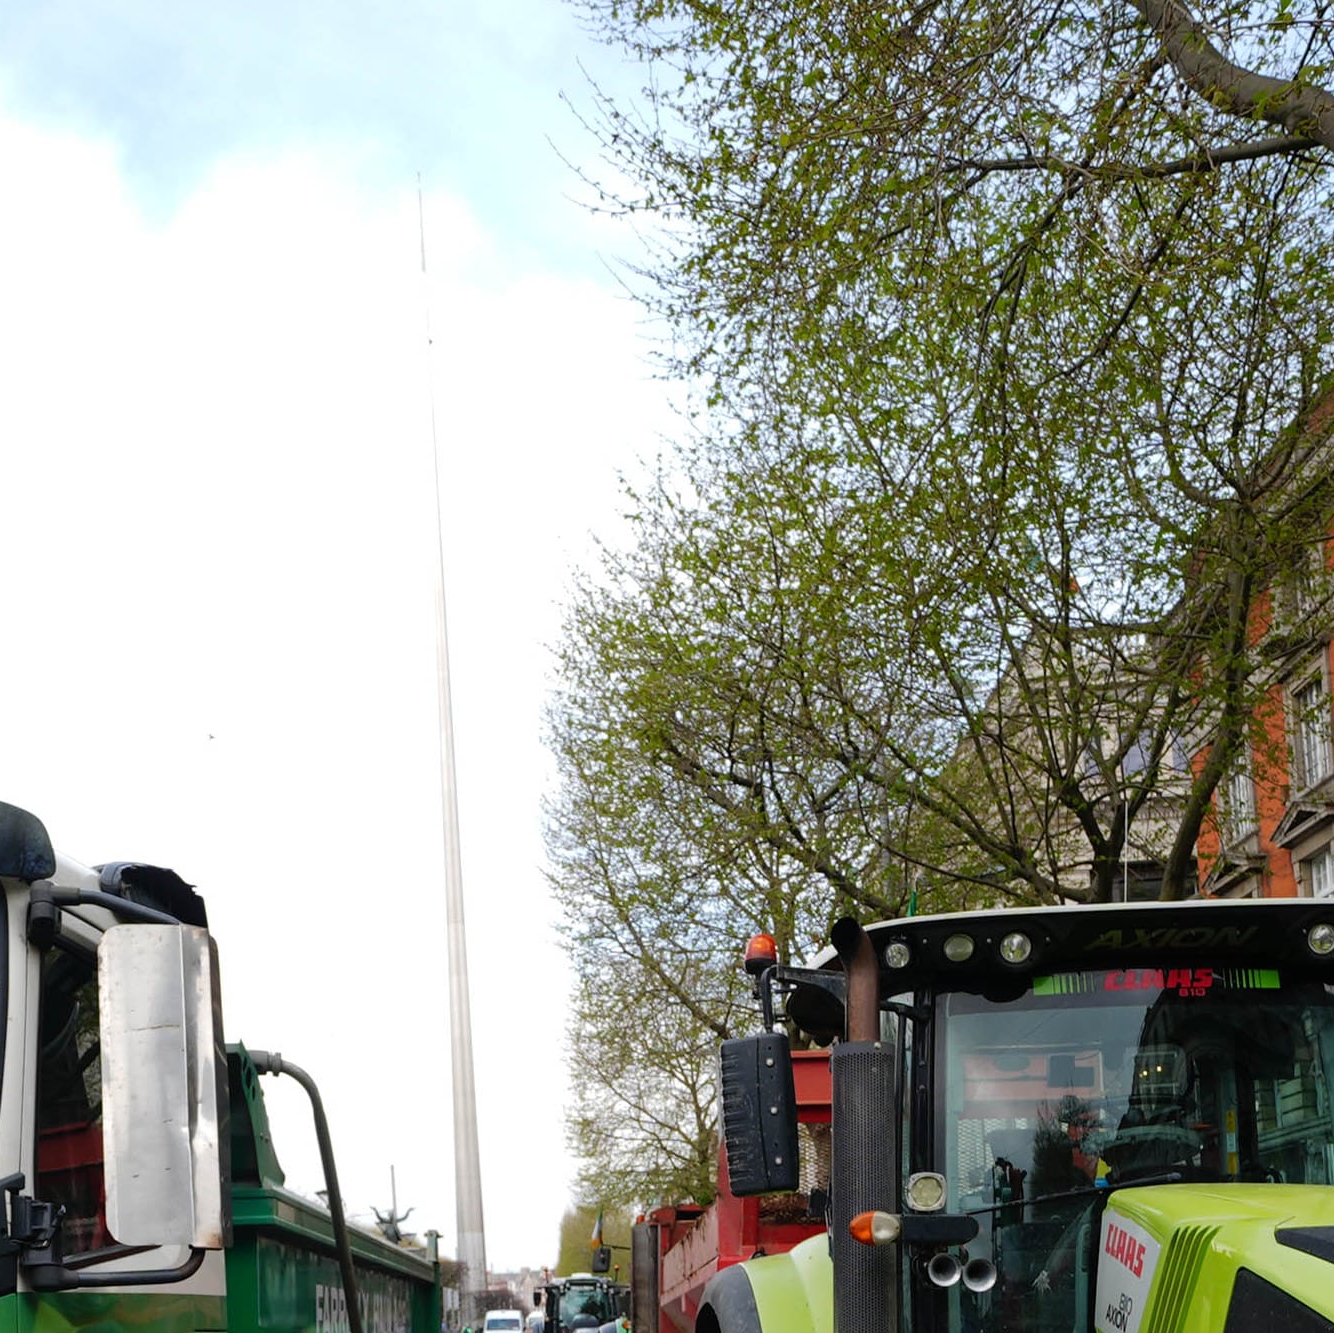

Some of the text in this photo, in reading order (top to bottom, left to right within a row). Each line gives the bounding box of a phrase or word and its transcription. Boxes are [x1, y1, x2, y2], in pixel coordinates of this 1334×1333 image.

[1084, 925, 1259, 949] AXION
[1104, 968, 1214, 991] CLAAS
[1105, 1223, 1146, 1279] CLAAS
[1106, 1303, 1128, 1333] AXION
